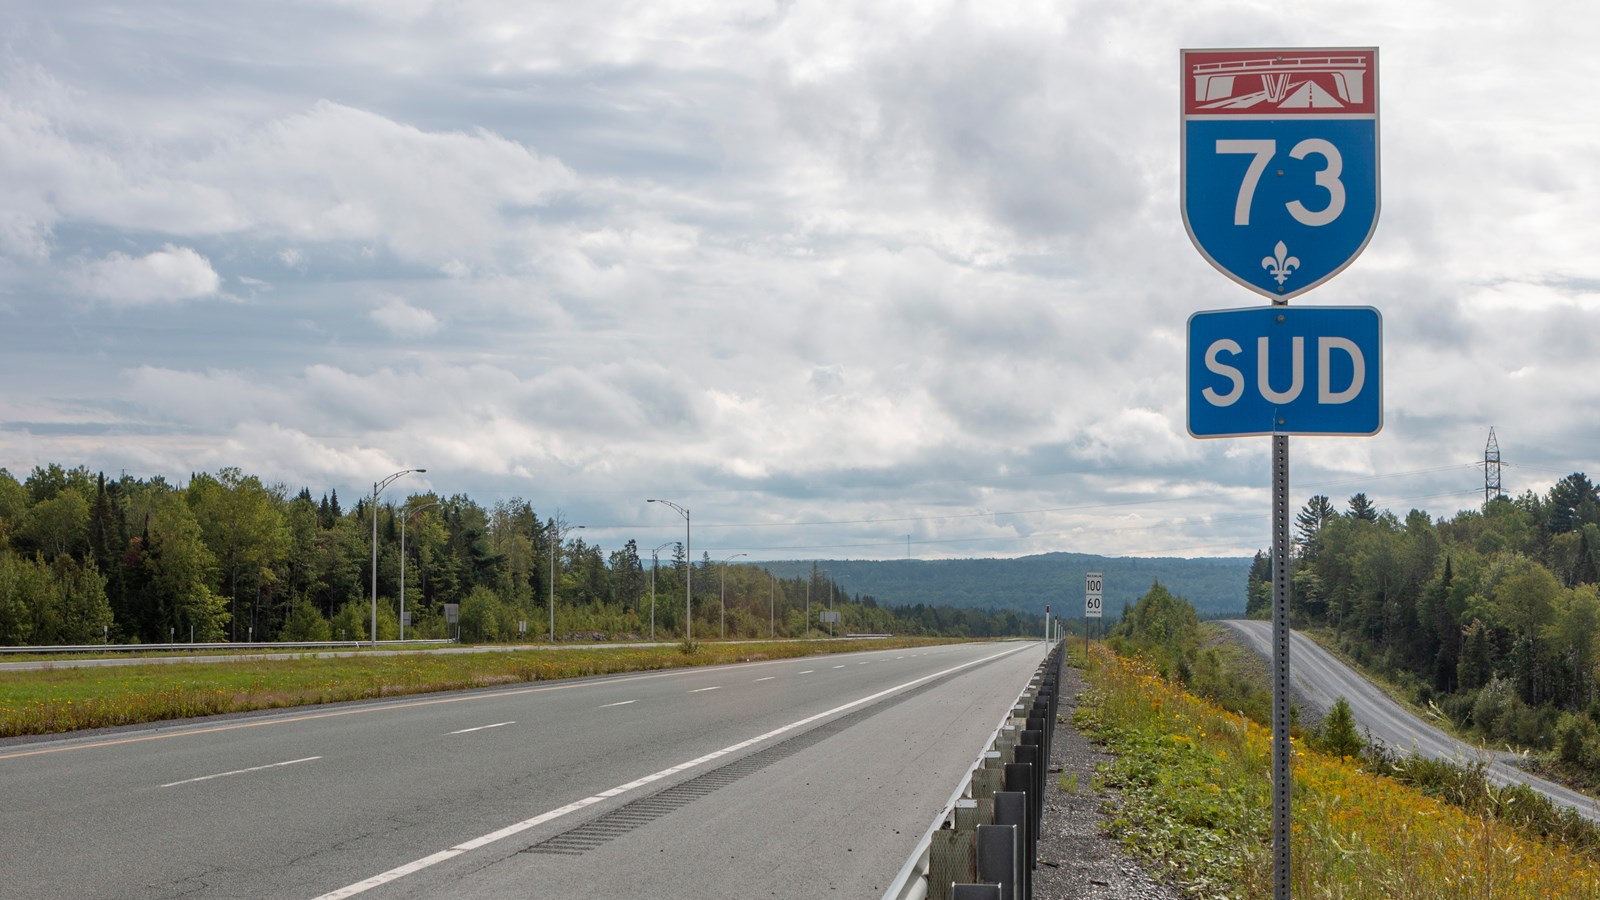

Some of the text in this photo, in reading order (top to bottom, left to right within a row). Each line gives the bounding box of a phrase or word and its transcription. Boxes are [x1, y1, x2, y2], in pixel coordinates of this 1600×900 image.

[1215, 138, 1346, 227] 73
[1201, 336, 1366, 407] SUD
[1087, 580, 1101, 591] 100
[1087, 598, 1100, 608] 60
